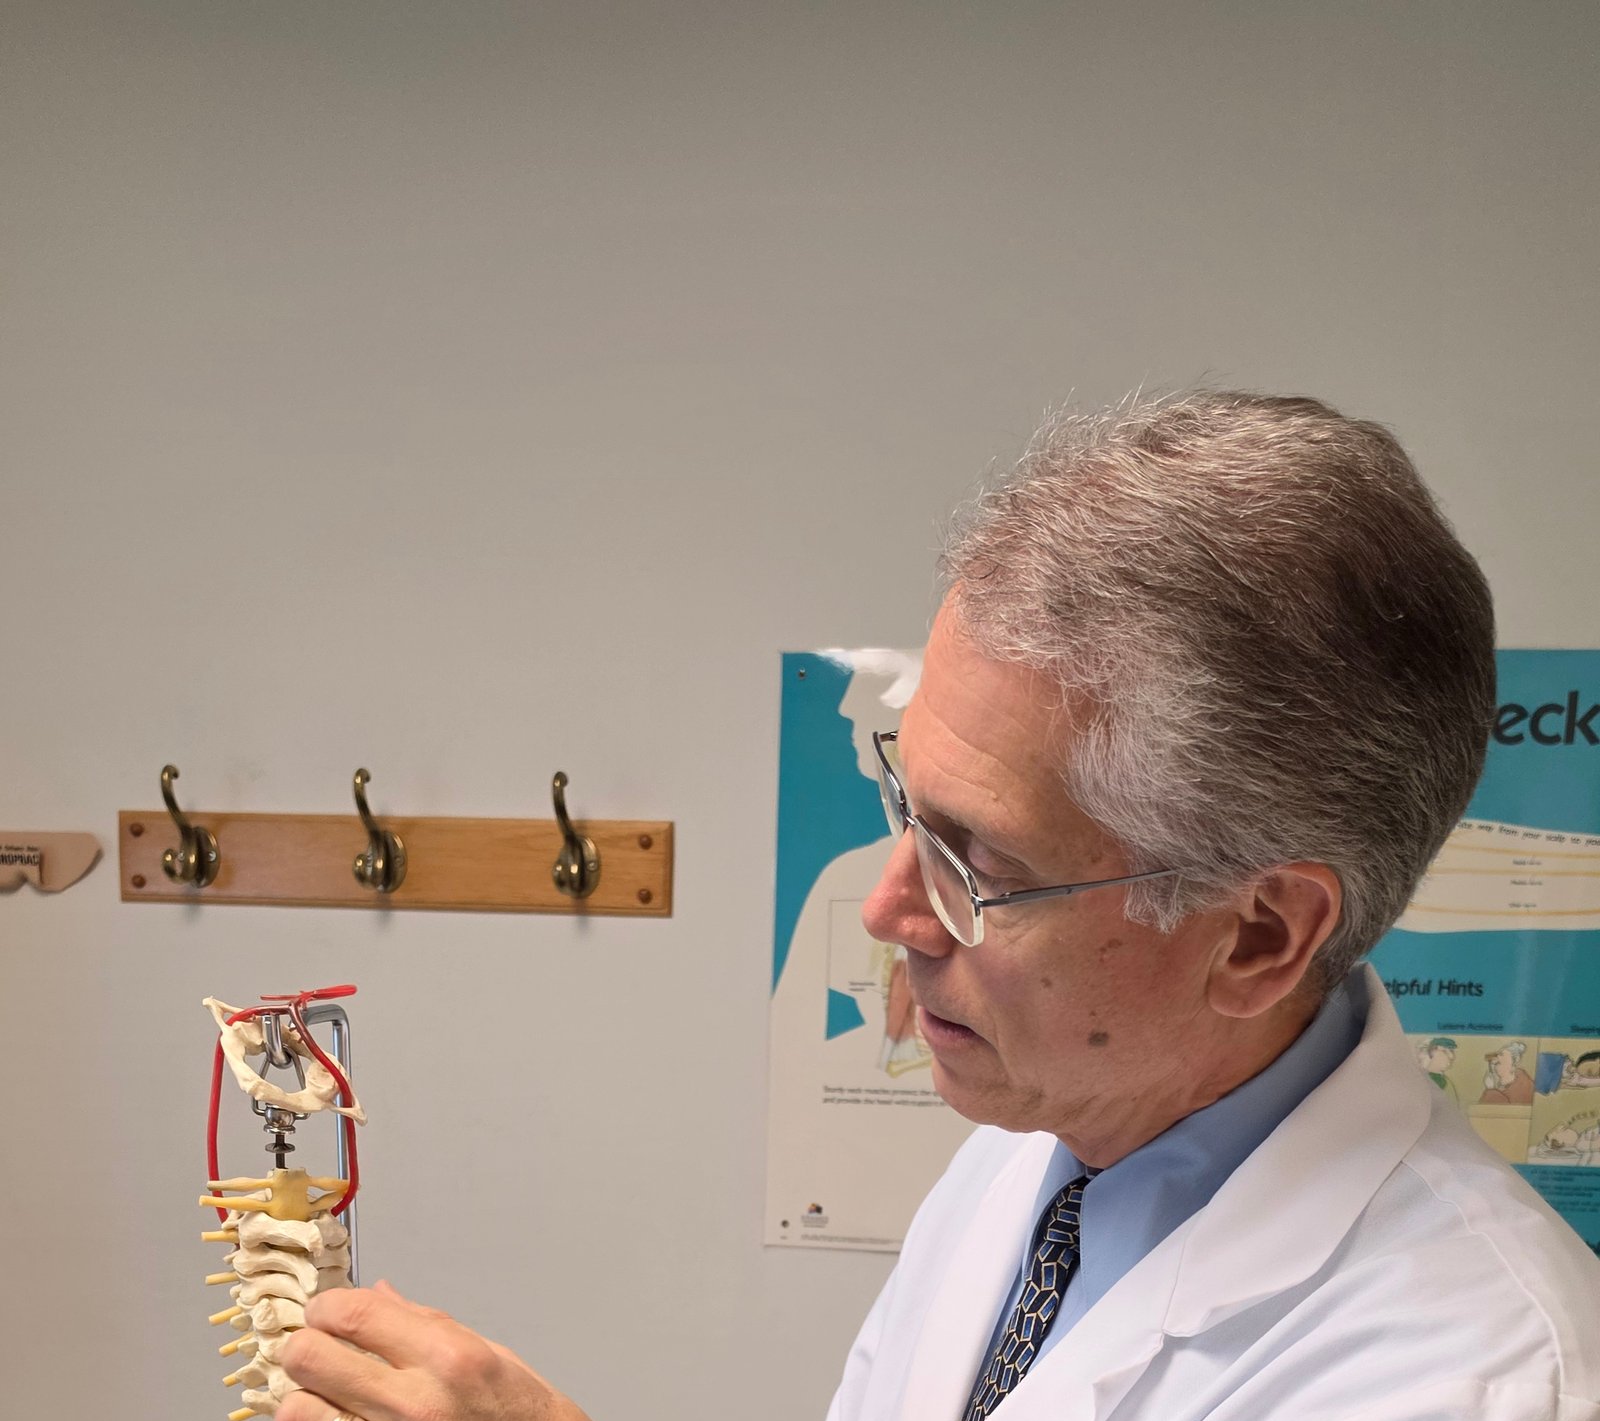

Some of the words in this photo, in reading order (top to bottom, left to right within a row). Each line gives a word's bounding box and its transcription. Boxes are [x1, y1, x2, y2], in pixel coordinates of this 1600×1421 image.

[1494, 689, 1600, 746] eck
[1384, 977, 1432, 999] elpful
[1438, 978, 1484, 997] Hints
